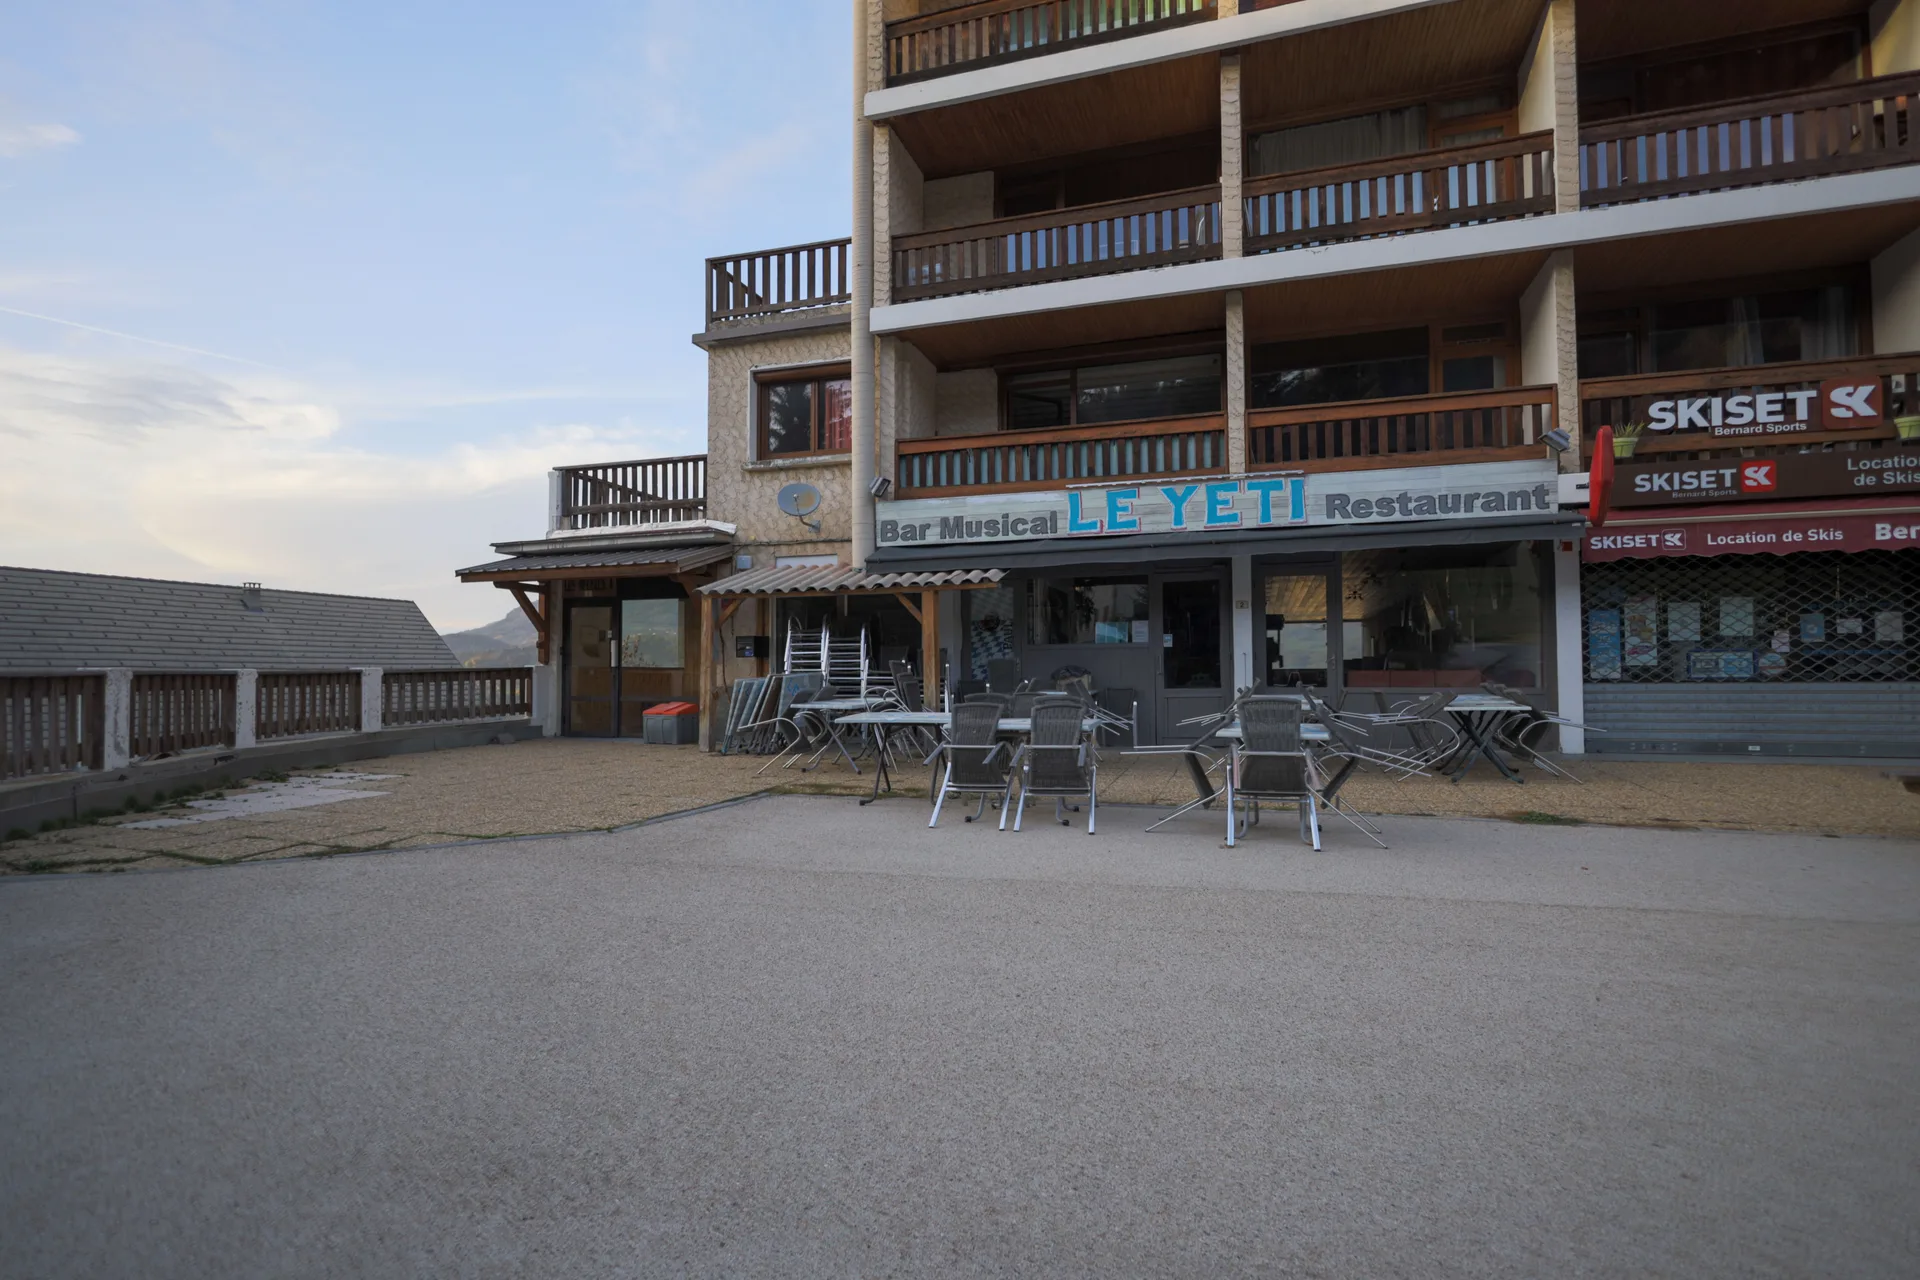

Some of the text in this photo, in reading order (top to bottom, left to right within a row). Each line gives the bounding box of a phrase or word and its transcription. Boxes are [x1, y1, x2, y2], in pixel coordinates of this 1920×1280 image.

[1647, 389, 1818, 431] SKISET
[1714, 421, 1807, 436] Bernard Sports
[1847, 455, 1920, 471] Locatio
[1634, 468, 1737, 493] SKISET
[1853, 470, 1920, 486] de Skis
[1325, 482, 1551, 519] Restaurant
[1672, 488, 1737, 499] Bernard Sports
[1067, 477, 1308, 535] LE YETI
[880, 510, 1058, 543] Bar Musical
[1590, 534, 1660, 550] SKISET
[1707, 527, 1844, 545] Location de Skis
